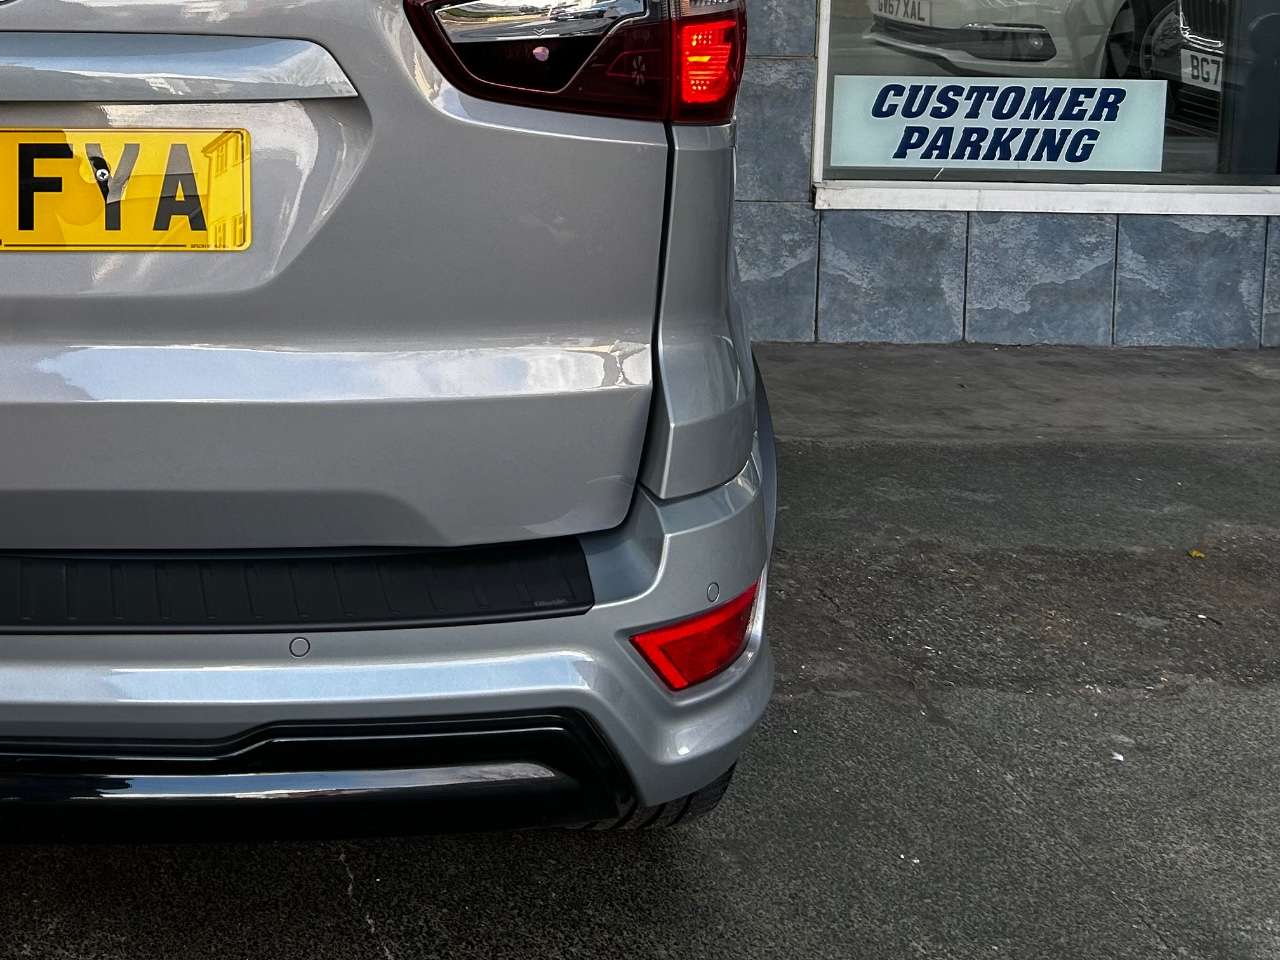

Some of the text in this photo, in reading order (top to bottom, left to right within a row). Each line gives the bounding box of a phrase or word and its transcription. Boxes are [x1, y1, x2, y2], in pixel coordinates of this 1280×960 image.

[903, 0, 926, 22] XAL
[871, 83, 1127, 122] CUSTOMER
[892, 125, 1101, 163] PARKING
[17, 142, 208, 231] FYA
